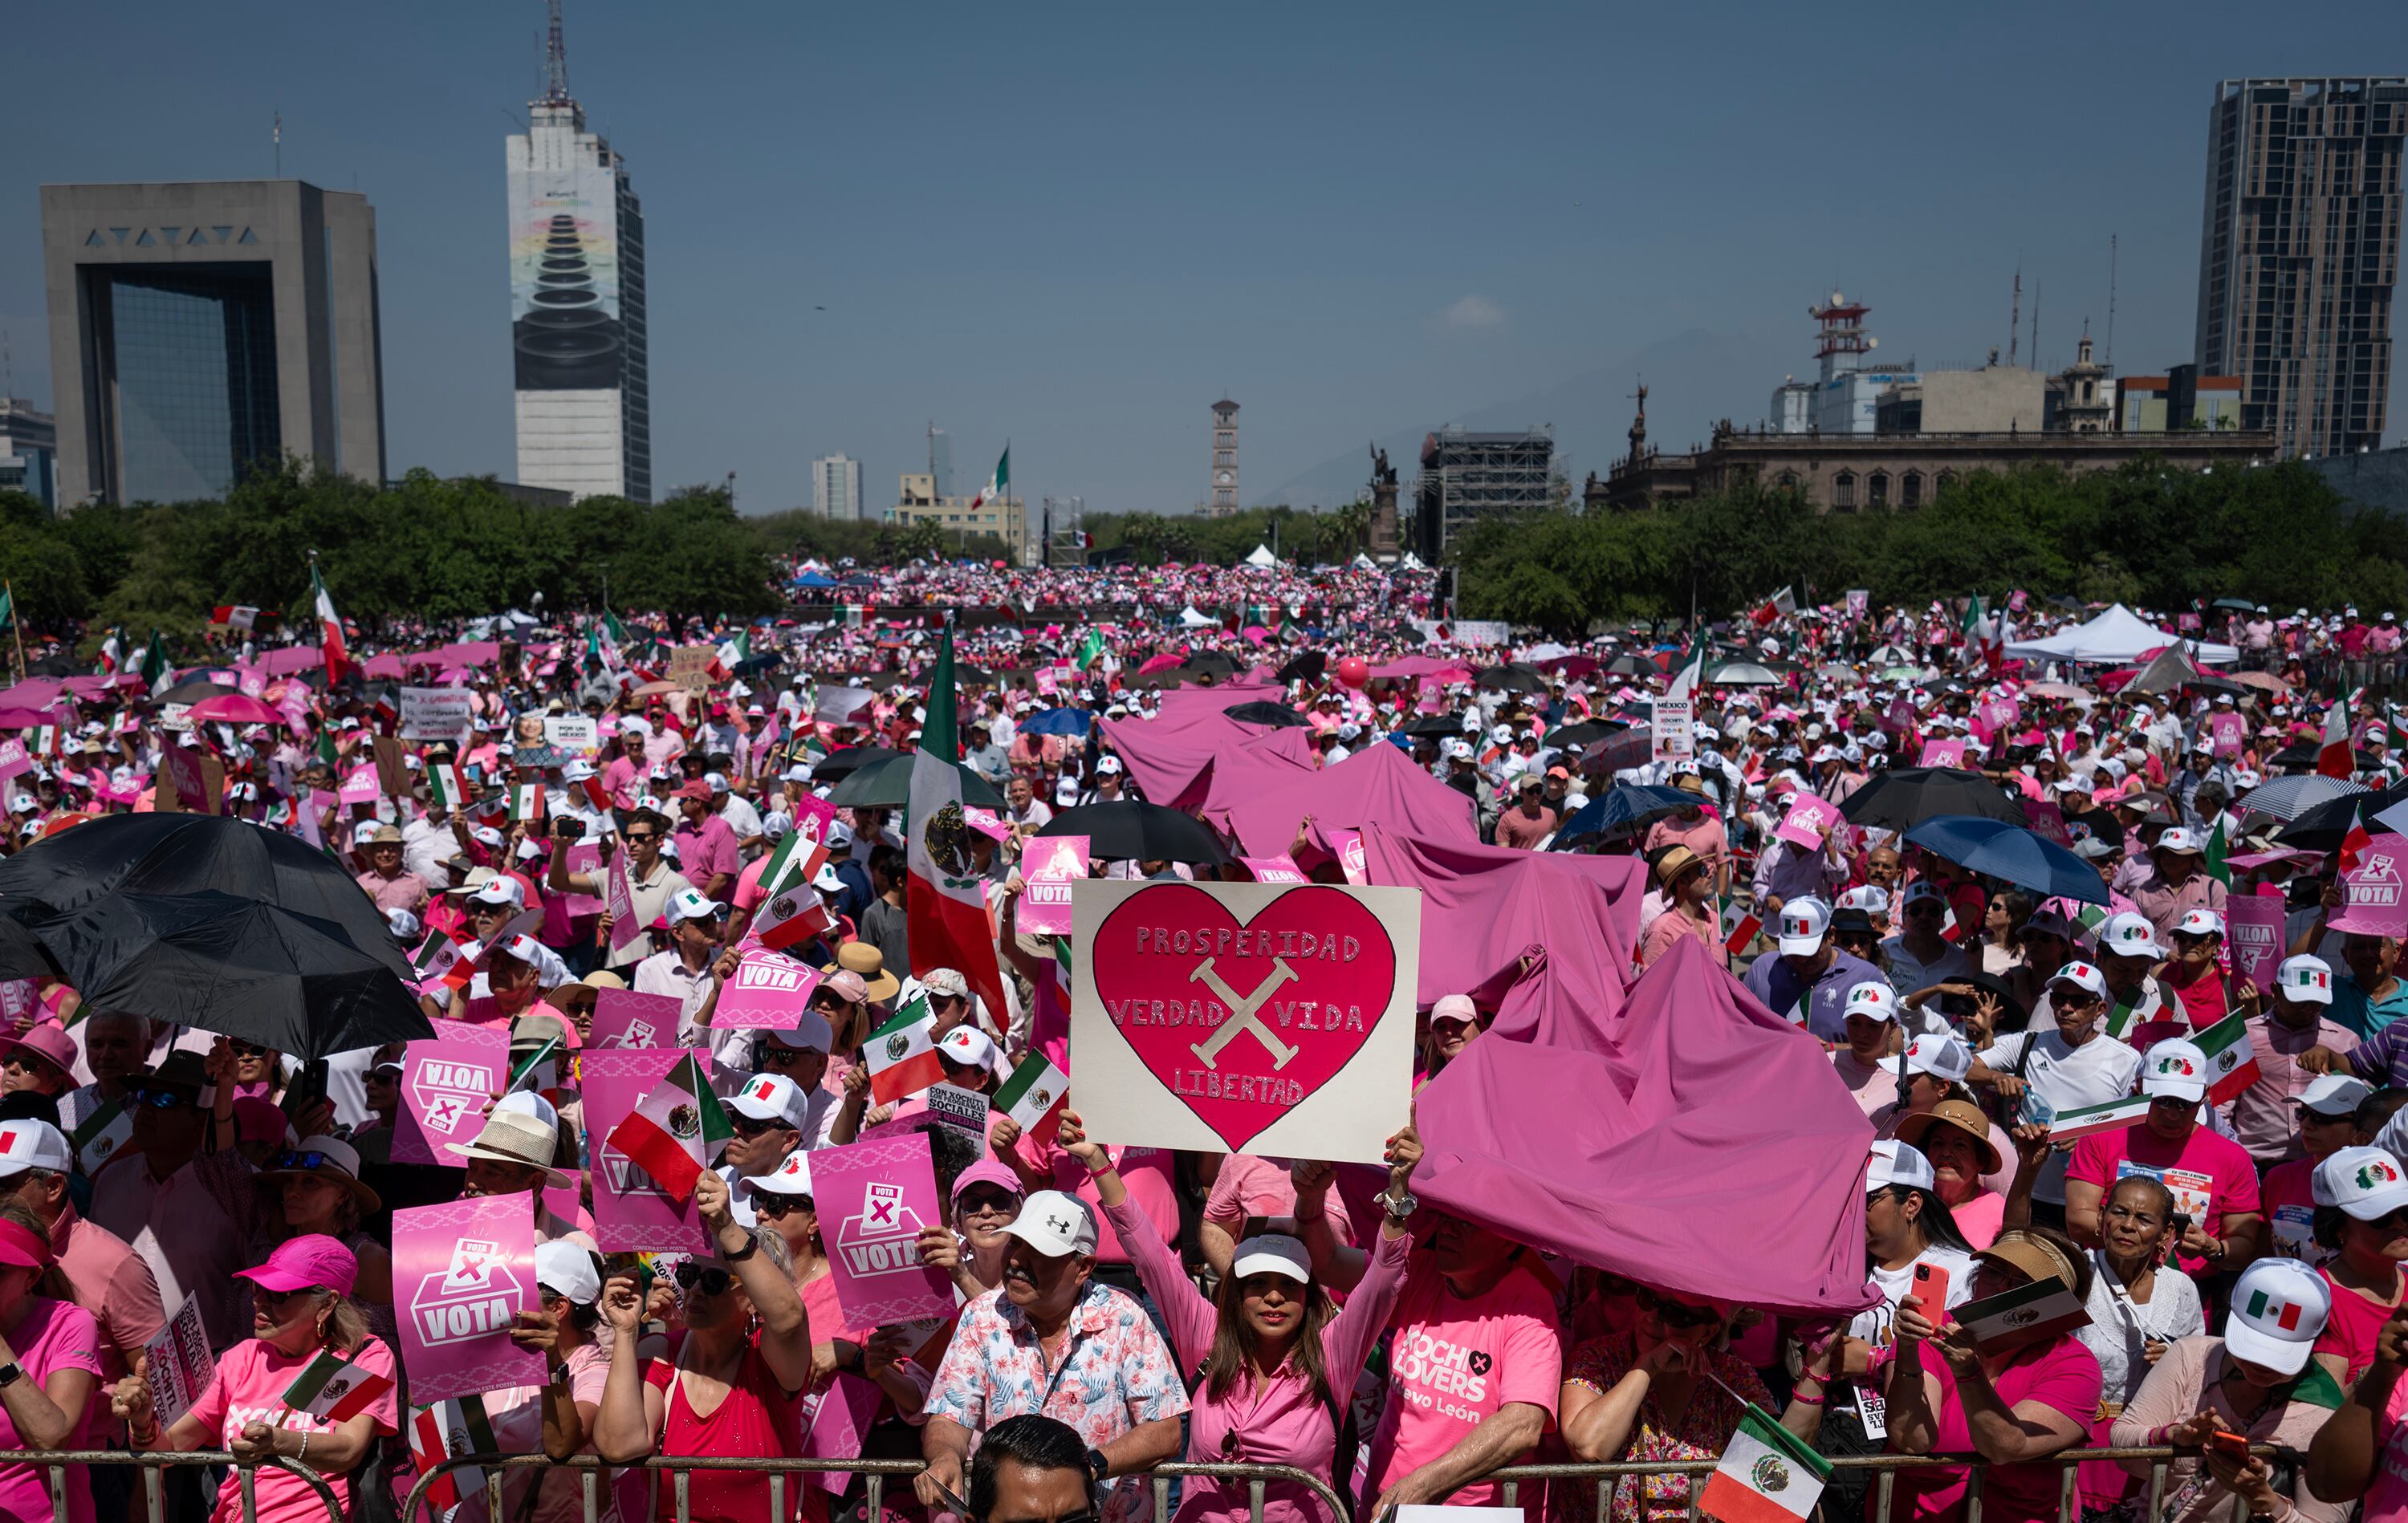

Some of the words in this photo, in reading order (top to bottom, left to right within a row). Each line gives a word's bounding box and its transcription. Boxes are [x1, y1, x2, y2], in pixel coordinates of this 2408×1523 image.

[1263, 871, 1298, 881] VOTA
[1032, 886, 1072, 901] VOTA
[2349, 887, 2394, 903] VOTA
[1137, 926, 1361, 962] PROSPERIDAD
[2236, 926, 2272, 943] VOTA
[742, 965, 798, 988] VOTA
[2, 981, 21, 1016] OTA
[1108, 999, 1225, 1027] VERDAD
[1274, 1001, 1365, 1033] VIDA
[426, 1063, 485, 1091] VOTA
[1173, 1068, 1304, 1107] LIBERTAD
[930, 1092, 942, 1100] LOS
[930, 1086, 946, 1096] CON
[949, 1091, 985, 1107] XÓCHITL
[929, 1098, 985, 1122] SOCIALES
[943, 1113, 983, 1131] QUEDAN
[431, 1119, 446, 1129] VOTA
[876, 1188, 894, 1196] VOTA
[466, 1243, 487, 1253] VOTA
[848, 1239, 925, 1273] VOTA
[425, 1298, 513, 1340] VOTA
[880, 1316, 904, 1325] CONSERVA
[916, 1312, 934, 1320] POSTER
[145, 1344, 156, 1372] NOS
[179, 1311, 205, 1395] SOCIALES
[156, 1342, 177, 1413] XÓCHITL
[171, 1354, 189, 1411] MEJORAN
[1393, 1349, 1487, 1403] LOVERS
[150, 1372, 169, 1427] PROTEGE
[451, 1387, 482, 1397] CONSERVA
[482, 1384, 495, 1392] ESTE
[495, 1381, 517, 1390] POSTER
[1436, 1397, 1480, 1424] León
